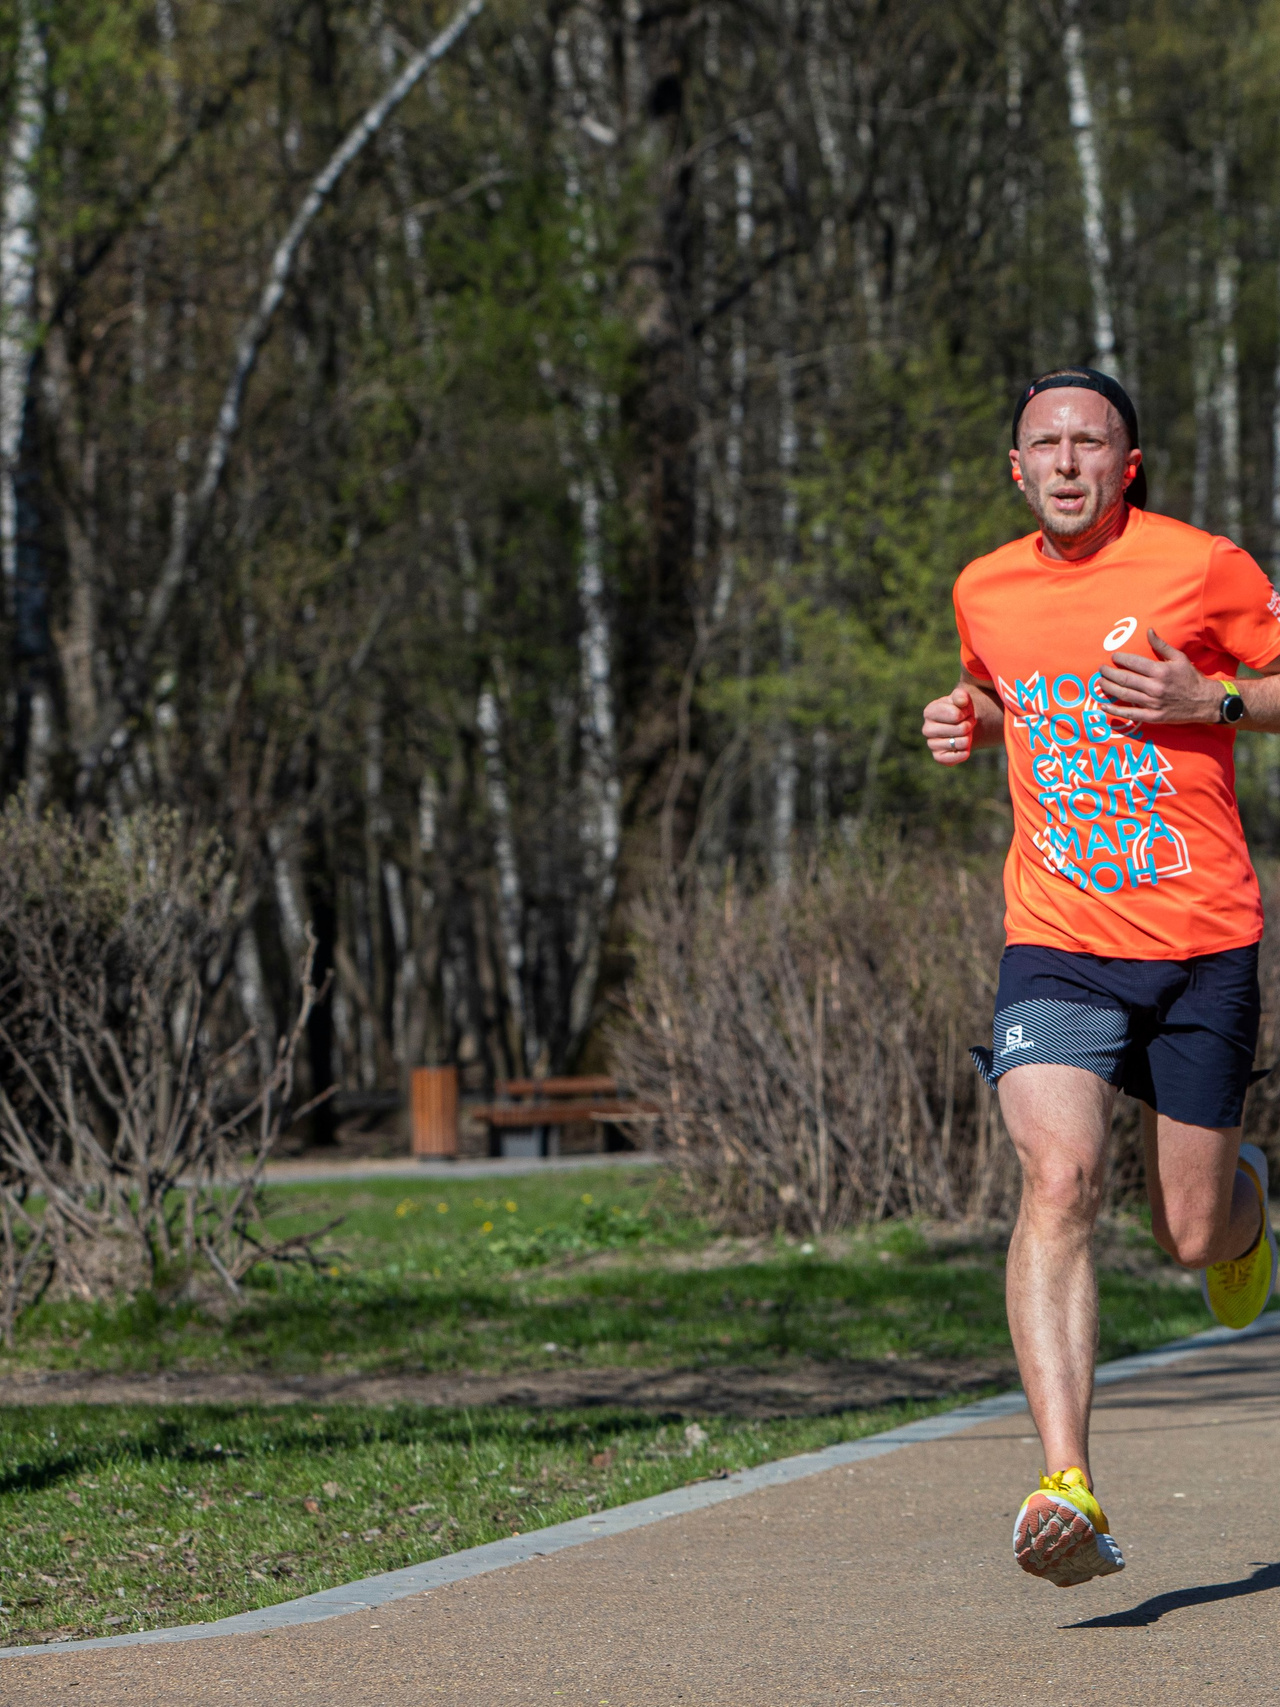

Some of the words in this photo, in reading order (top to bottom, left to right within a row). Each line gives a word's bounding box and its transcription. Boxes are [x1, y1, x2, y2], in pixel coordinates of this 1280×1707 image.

[1025, 710, 1112, 750] КОВ
[1038, 776, 1163, 824] ПОЛУ
[1050, 812, 1175, 860] МАРА
